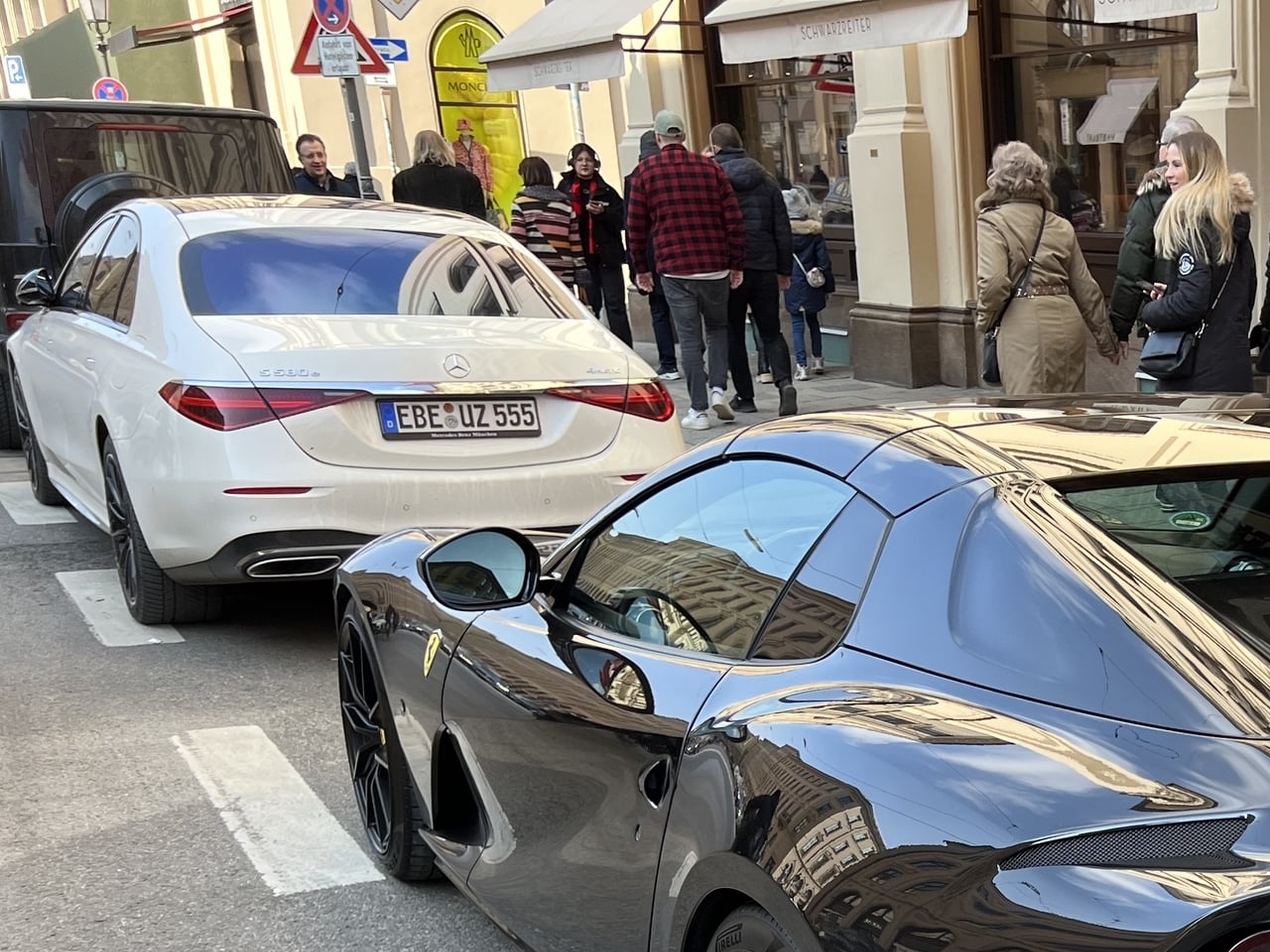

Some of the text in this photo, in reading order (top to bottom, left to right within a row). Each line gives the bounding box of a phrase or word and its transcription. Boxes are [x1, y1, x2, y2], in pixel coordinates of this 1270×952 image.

[800, 17, 872, 40] SCHWARZREITER
[396, 403, 535, 429] EBE UZ 555
